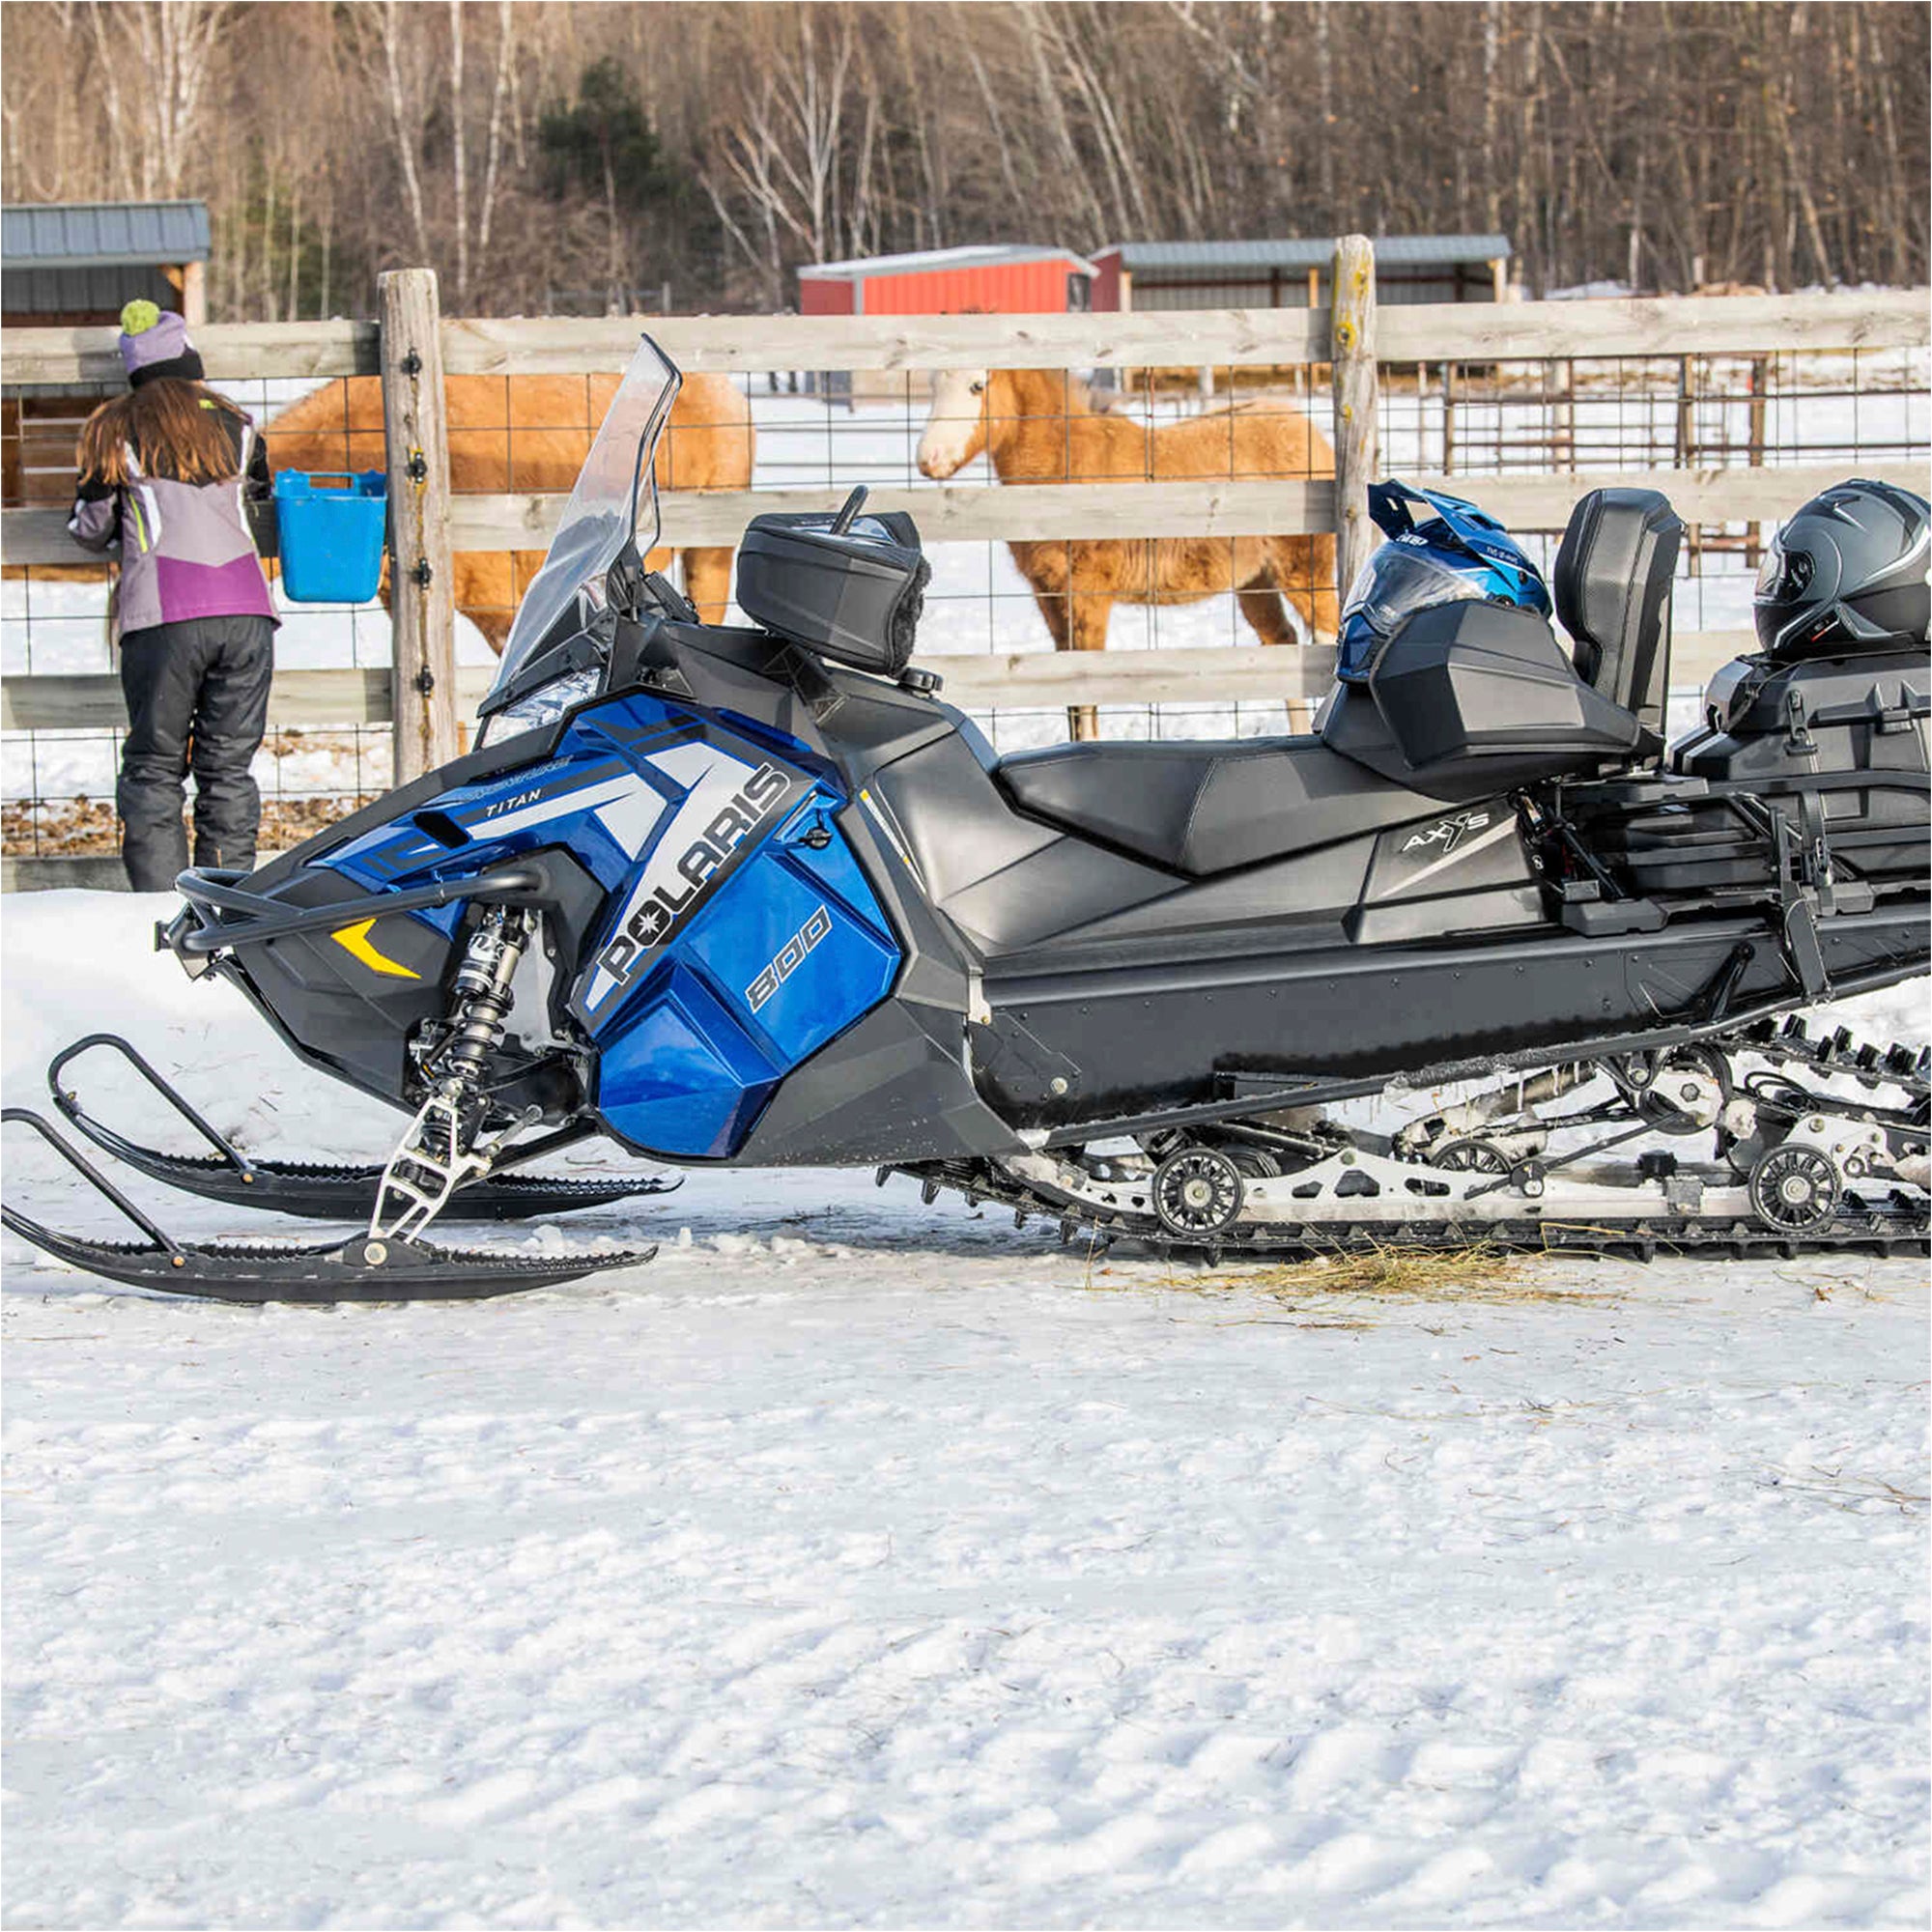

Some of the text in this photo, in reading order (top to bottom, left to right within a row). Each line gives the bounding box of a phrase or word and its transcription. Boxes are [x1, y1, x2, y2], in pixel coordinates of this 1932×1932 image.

[486, 788, 541, 817] TITAN
[1402, 812, 1489, 852] AXYS
[597, 762, 790, 985] POLARIS
[745, 904, 833, 1014] 800
